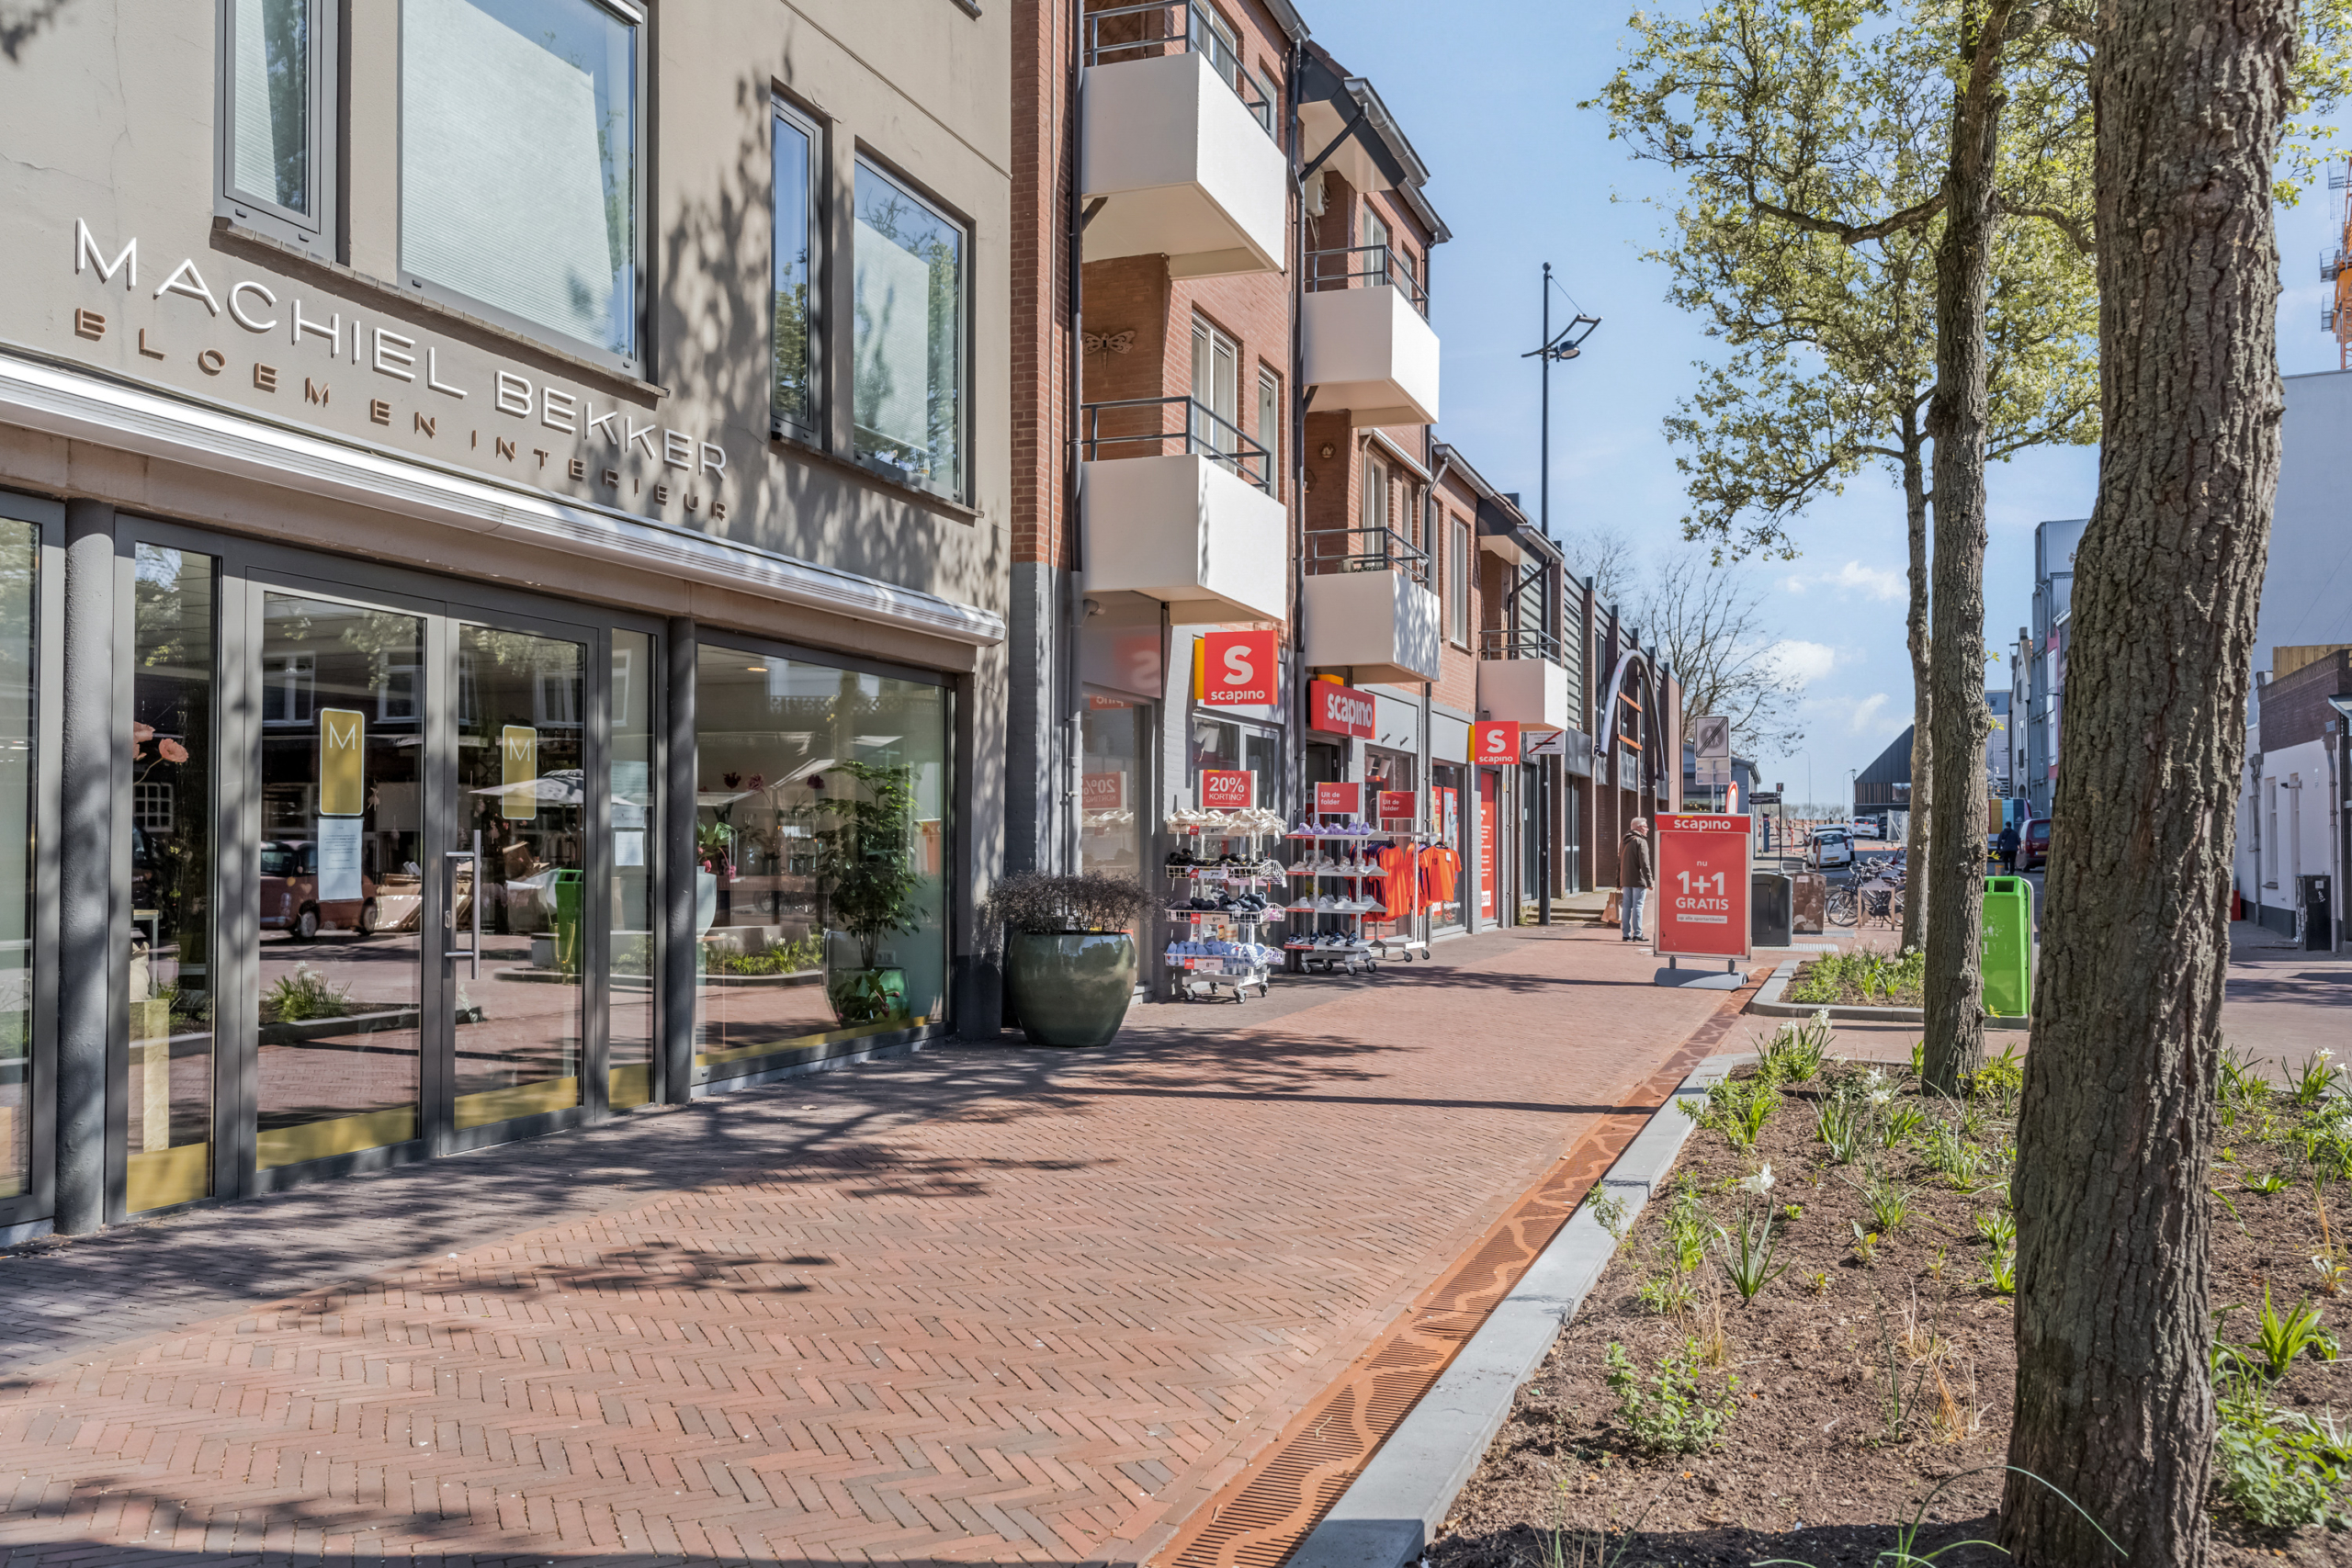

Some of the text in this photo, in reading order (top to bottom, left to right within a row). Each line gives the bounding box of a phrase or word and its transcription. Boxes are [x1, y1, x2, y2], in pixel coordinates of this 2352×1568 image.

[75, 217, 728, 481] MACHIEL BEKKER
[74, 308, 728, 522] BLOEM EN INTERIEUR
[1223, 645, 1254, 685] S
[1210, 689, 1265, 705] scapino
[1327, 693, 1374, 734] scapino
[330, 721, 356, 750] M
[1487, 729, 1507, 753] S
[509, 737, 531, 761] M
[1478, 755, 1513, 765] scapino
[1209, 776, 1245, 793] 20%
[1674, 819, 1731, 832] scapino
[1677, 871, 1724, 896] 1+1
[1676, 897, 1729, 910] GRATIS
